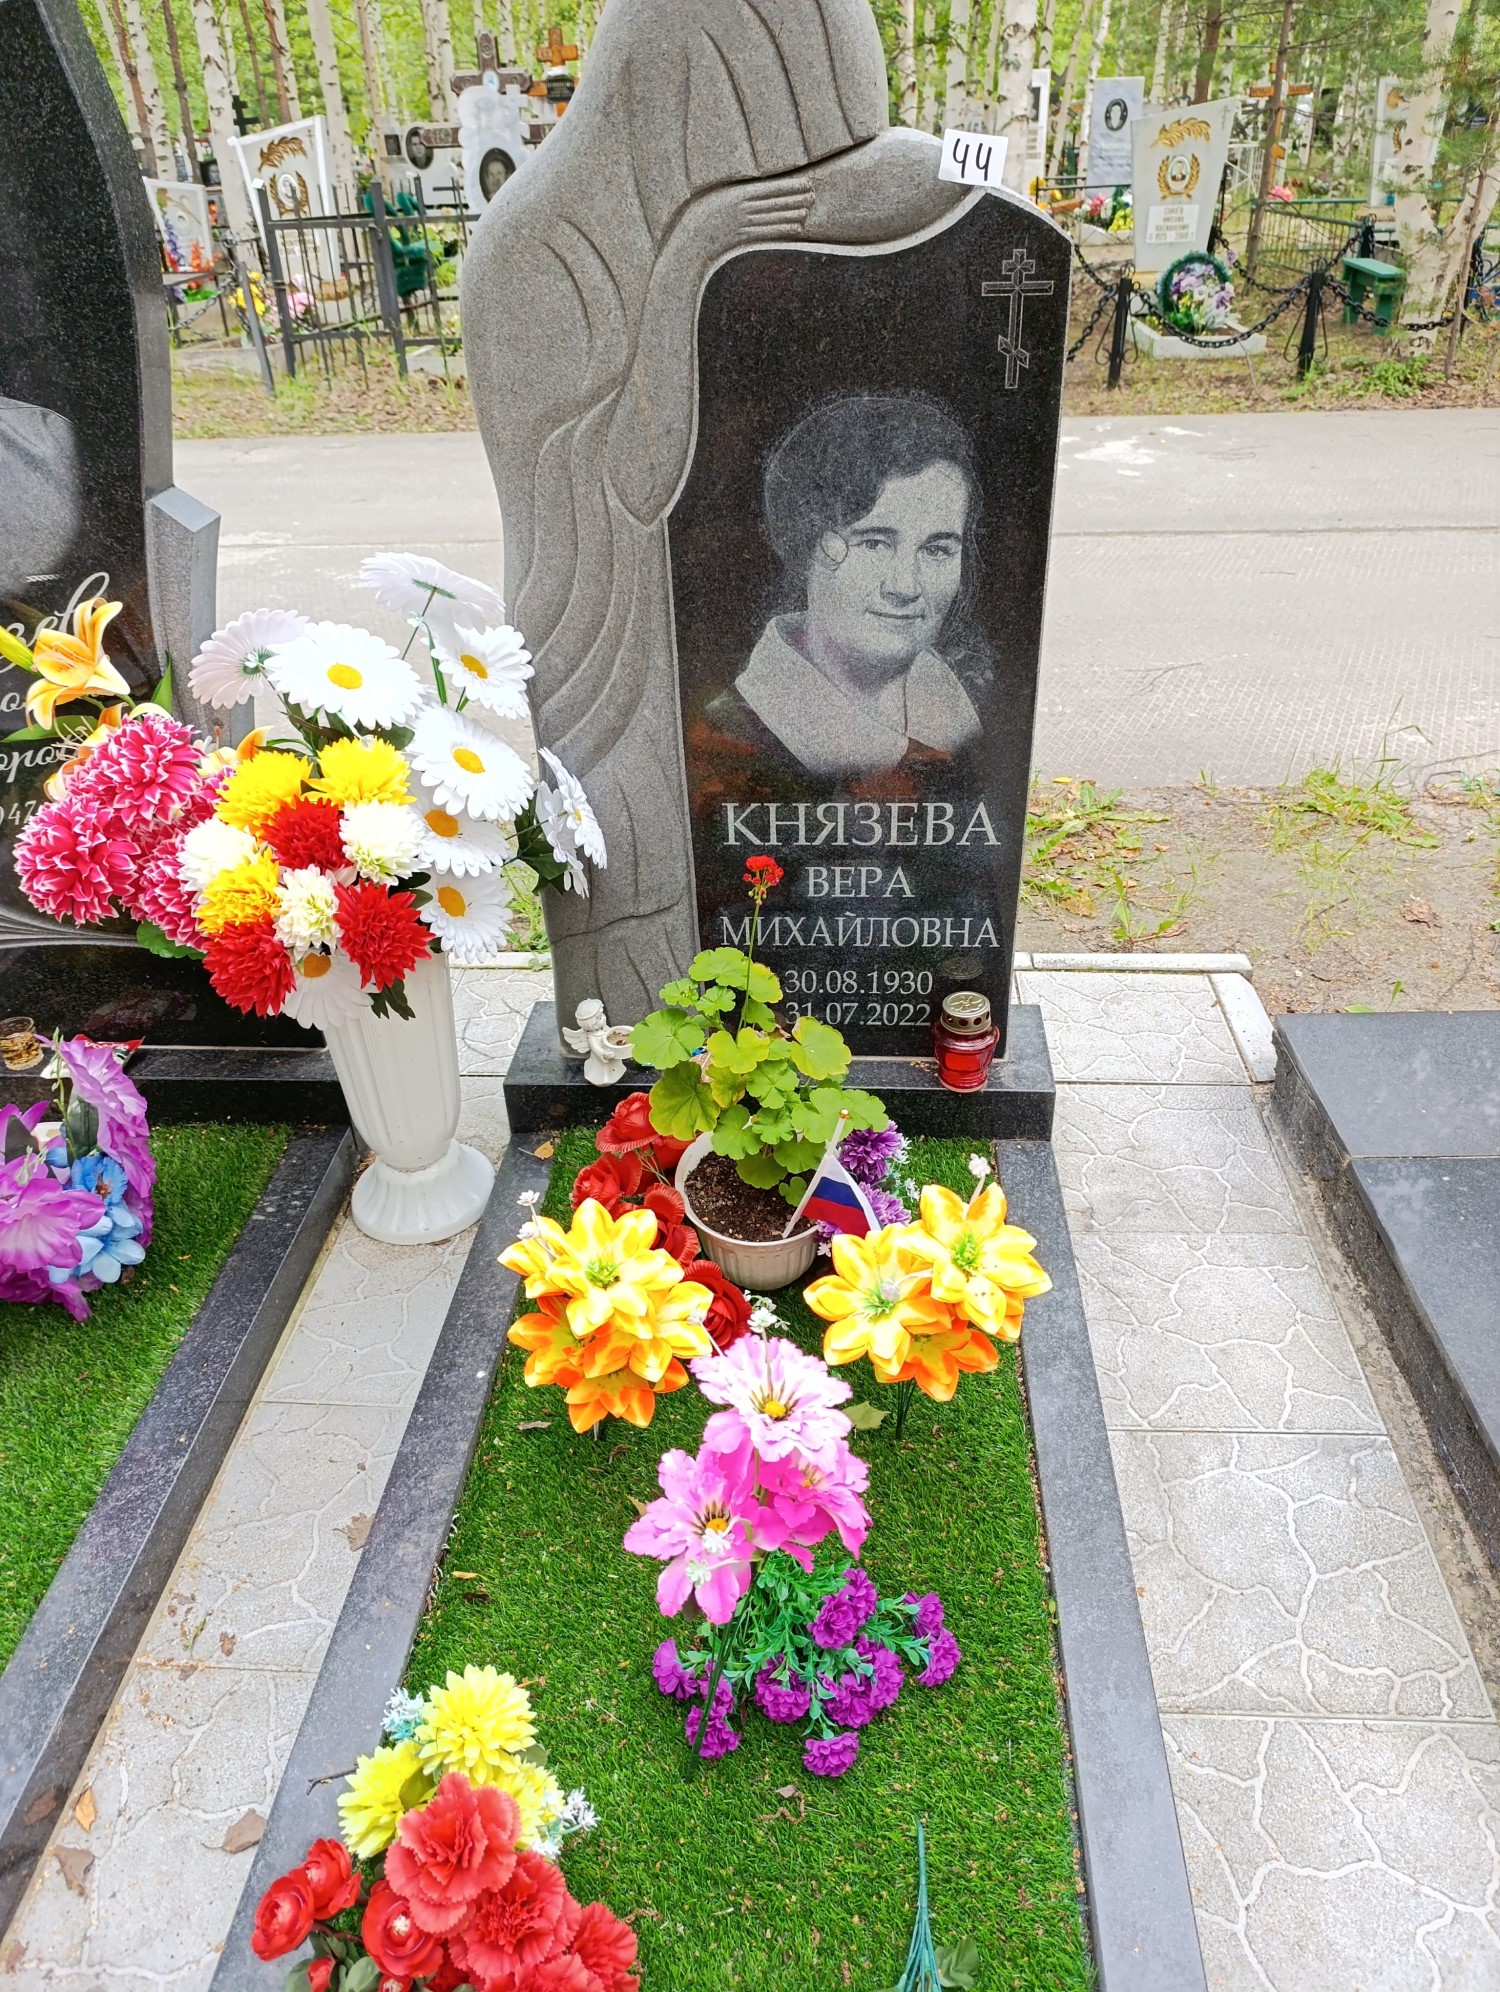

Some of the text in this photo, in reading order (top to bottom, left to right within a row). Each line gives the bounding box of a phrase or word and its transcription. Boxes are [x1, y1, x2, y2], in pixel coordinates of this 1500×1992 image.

[952, 138, 993, 182] 44
[721, 801, 1002, 847] КНЯЗЕВА
[805, 866, 915, 898] ВЕРА
[719, 911, 1001, 948] МИХАЙЛОВНА
[784, 970, 933, 995] 30.08.1930
[785, 1001, 932, 1027] 31.07.2022
